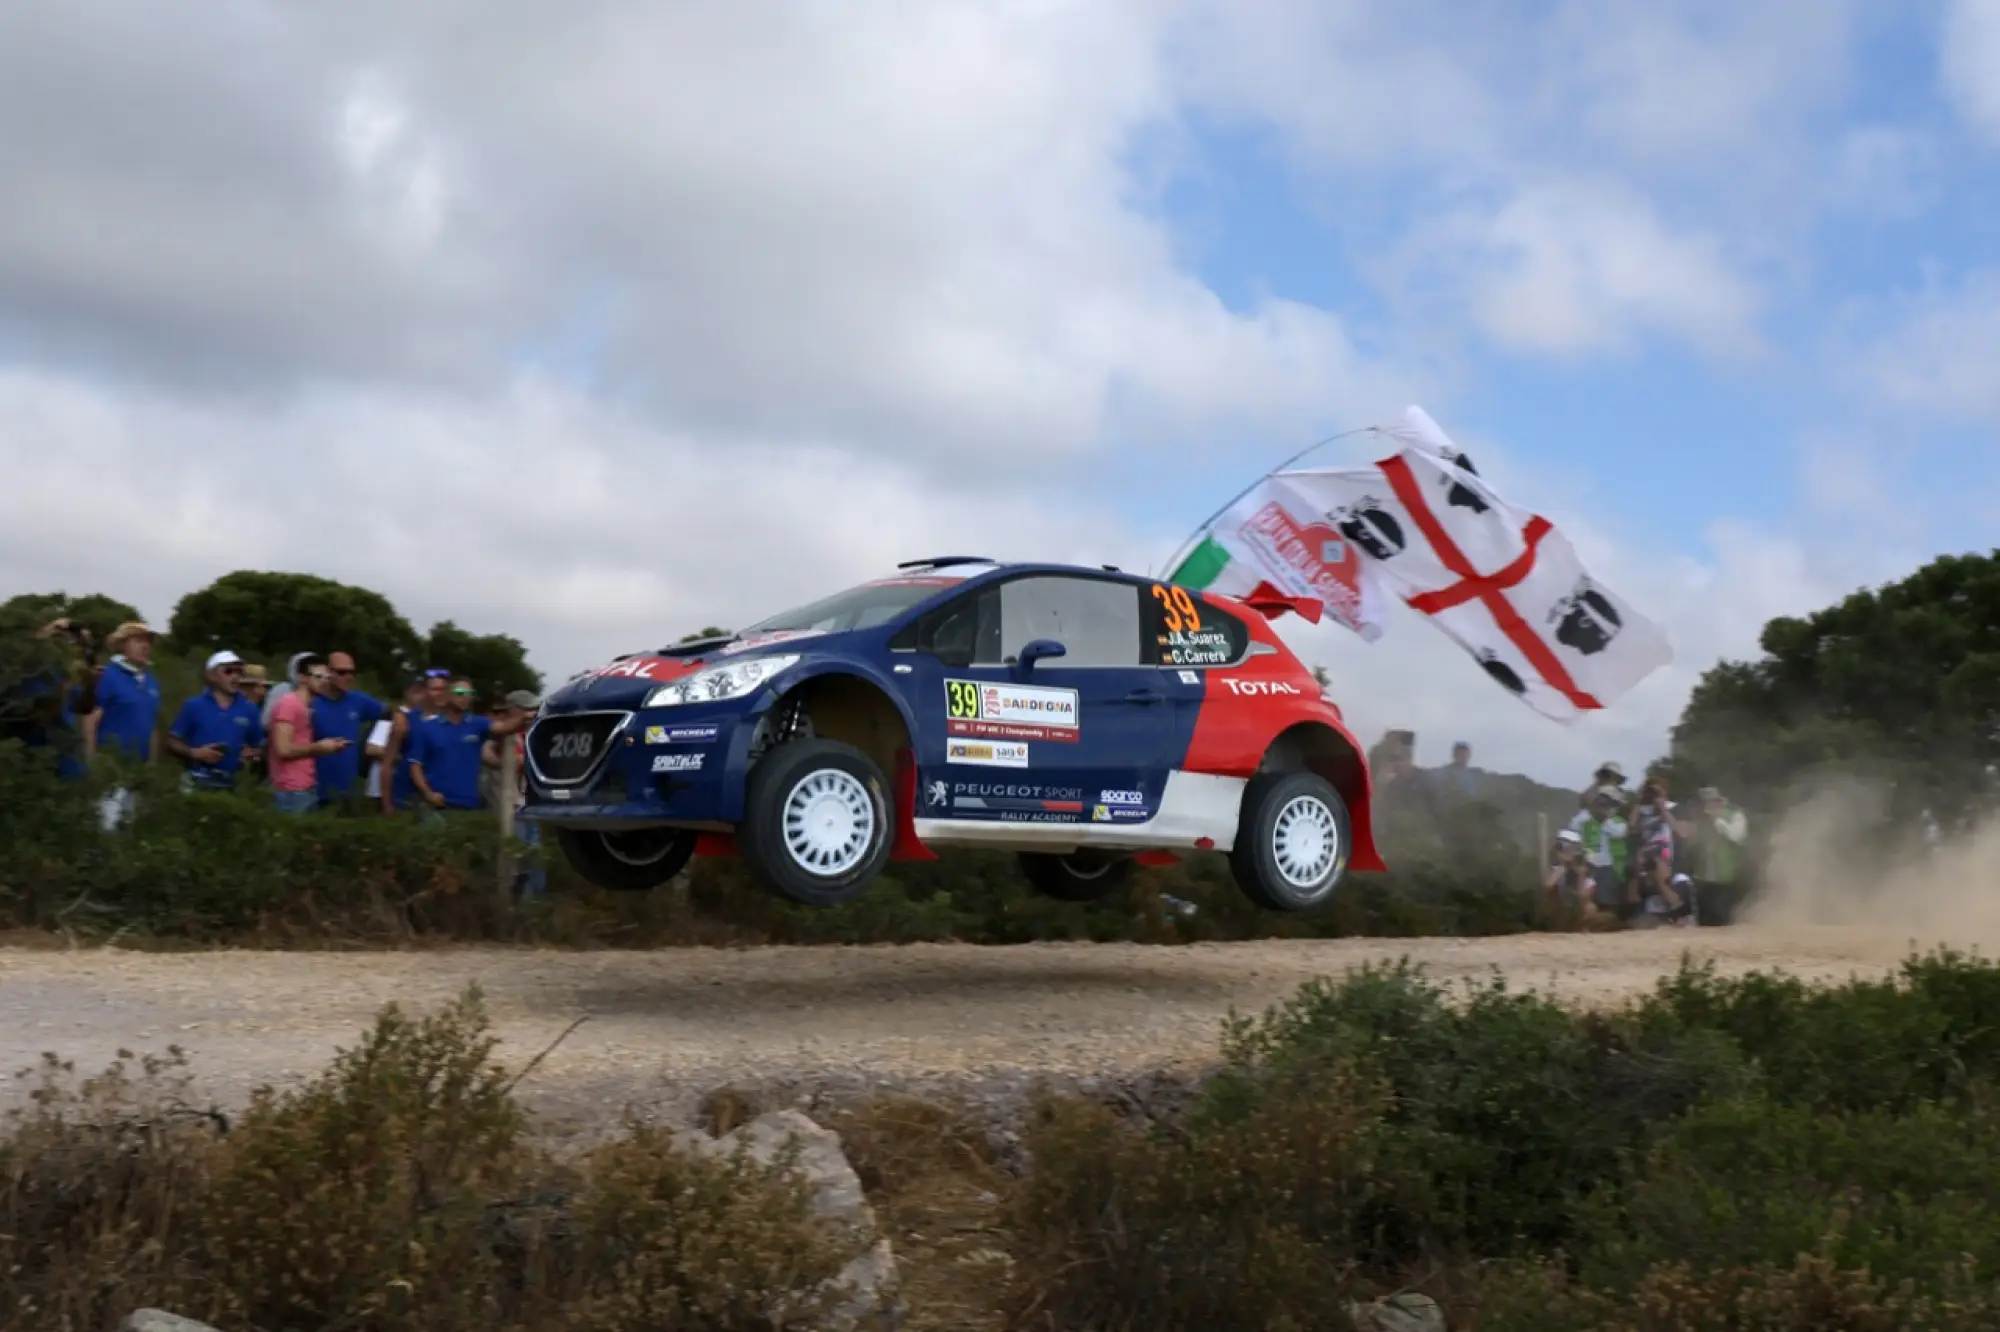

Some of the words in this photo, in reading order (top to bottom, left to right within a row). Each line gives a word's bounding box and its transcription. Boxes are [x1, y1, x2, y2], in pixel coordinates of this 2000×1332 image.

[1152, 584, 1201, 632] 39
[1220, 678, 1301, 696] TOTAL
[950, 682, 977, 718] 39
[549, 733, 594, 758] 208
[954, 783, 1042, 797] PEUGEOT
[1044, 786, 1082, 799] SPORT
[1101, 789, 1143, 804] sparco
[1001, 811, 1030, 821] RALLY
[1032, 812, 1077, 823] ACADEMY
